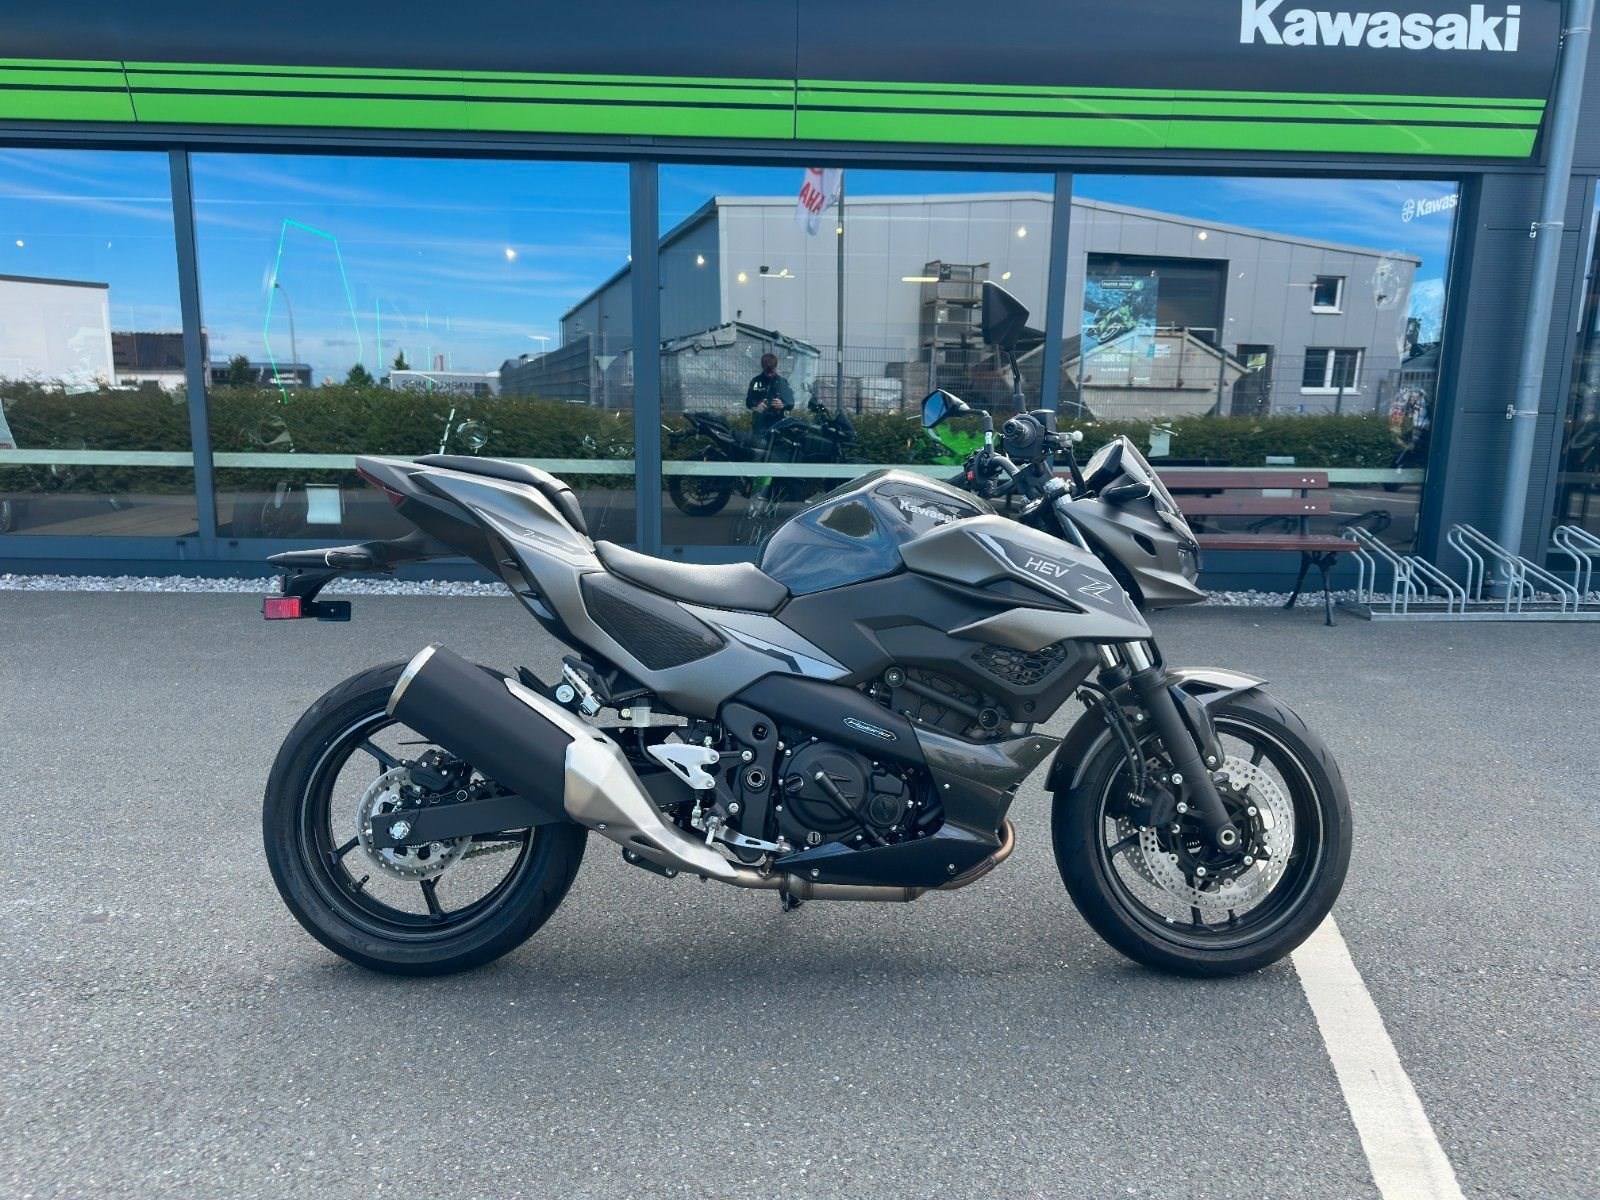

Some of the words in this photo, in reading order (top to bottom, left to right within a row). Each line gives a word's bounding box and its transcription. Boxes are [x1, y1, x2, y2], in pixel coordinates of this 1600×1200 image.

[1240, 0, 1520, 51] Kawasaki
[1416, 194, 1458, 217] Kawas
[899, 500, 958, 522] Kawasa
[1024, 556, 1070, 578] HEV
